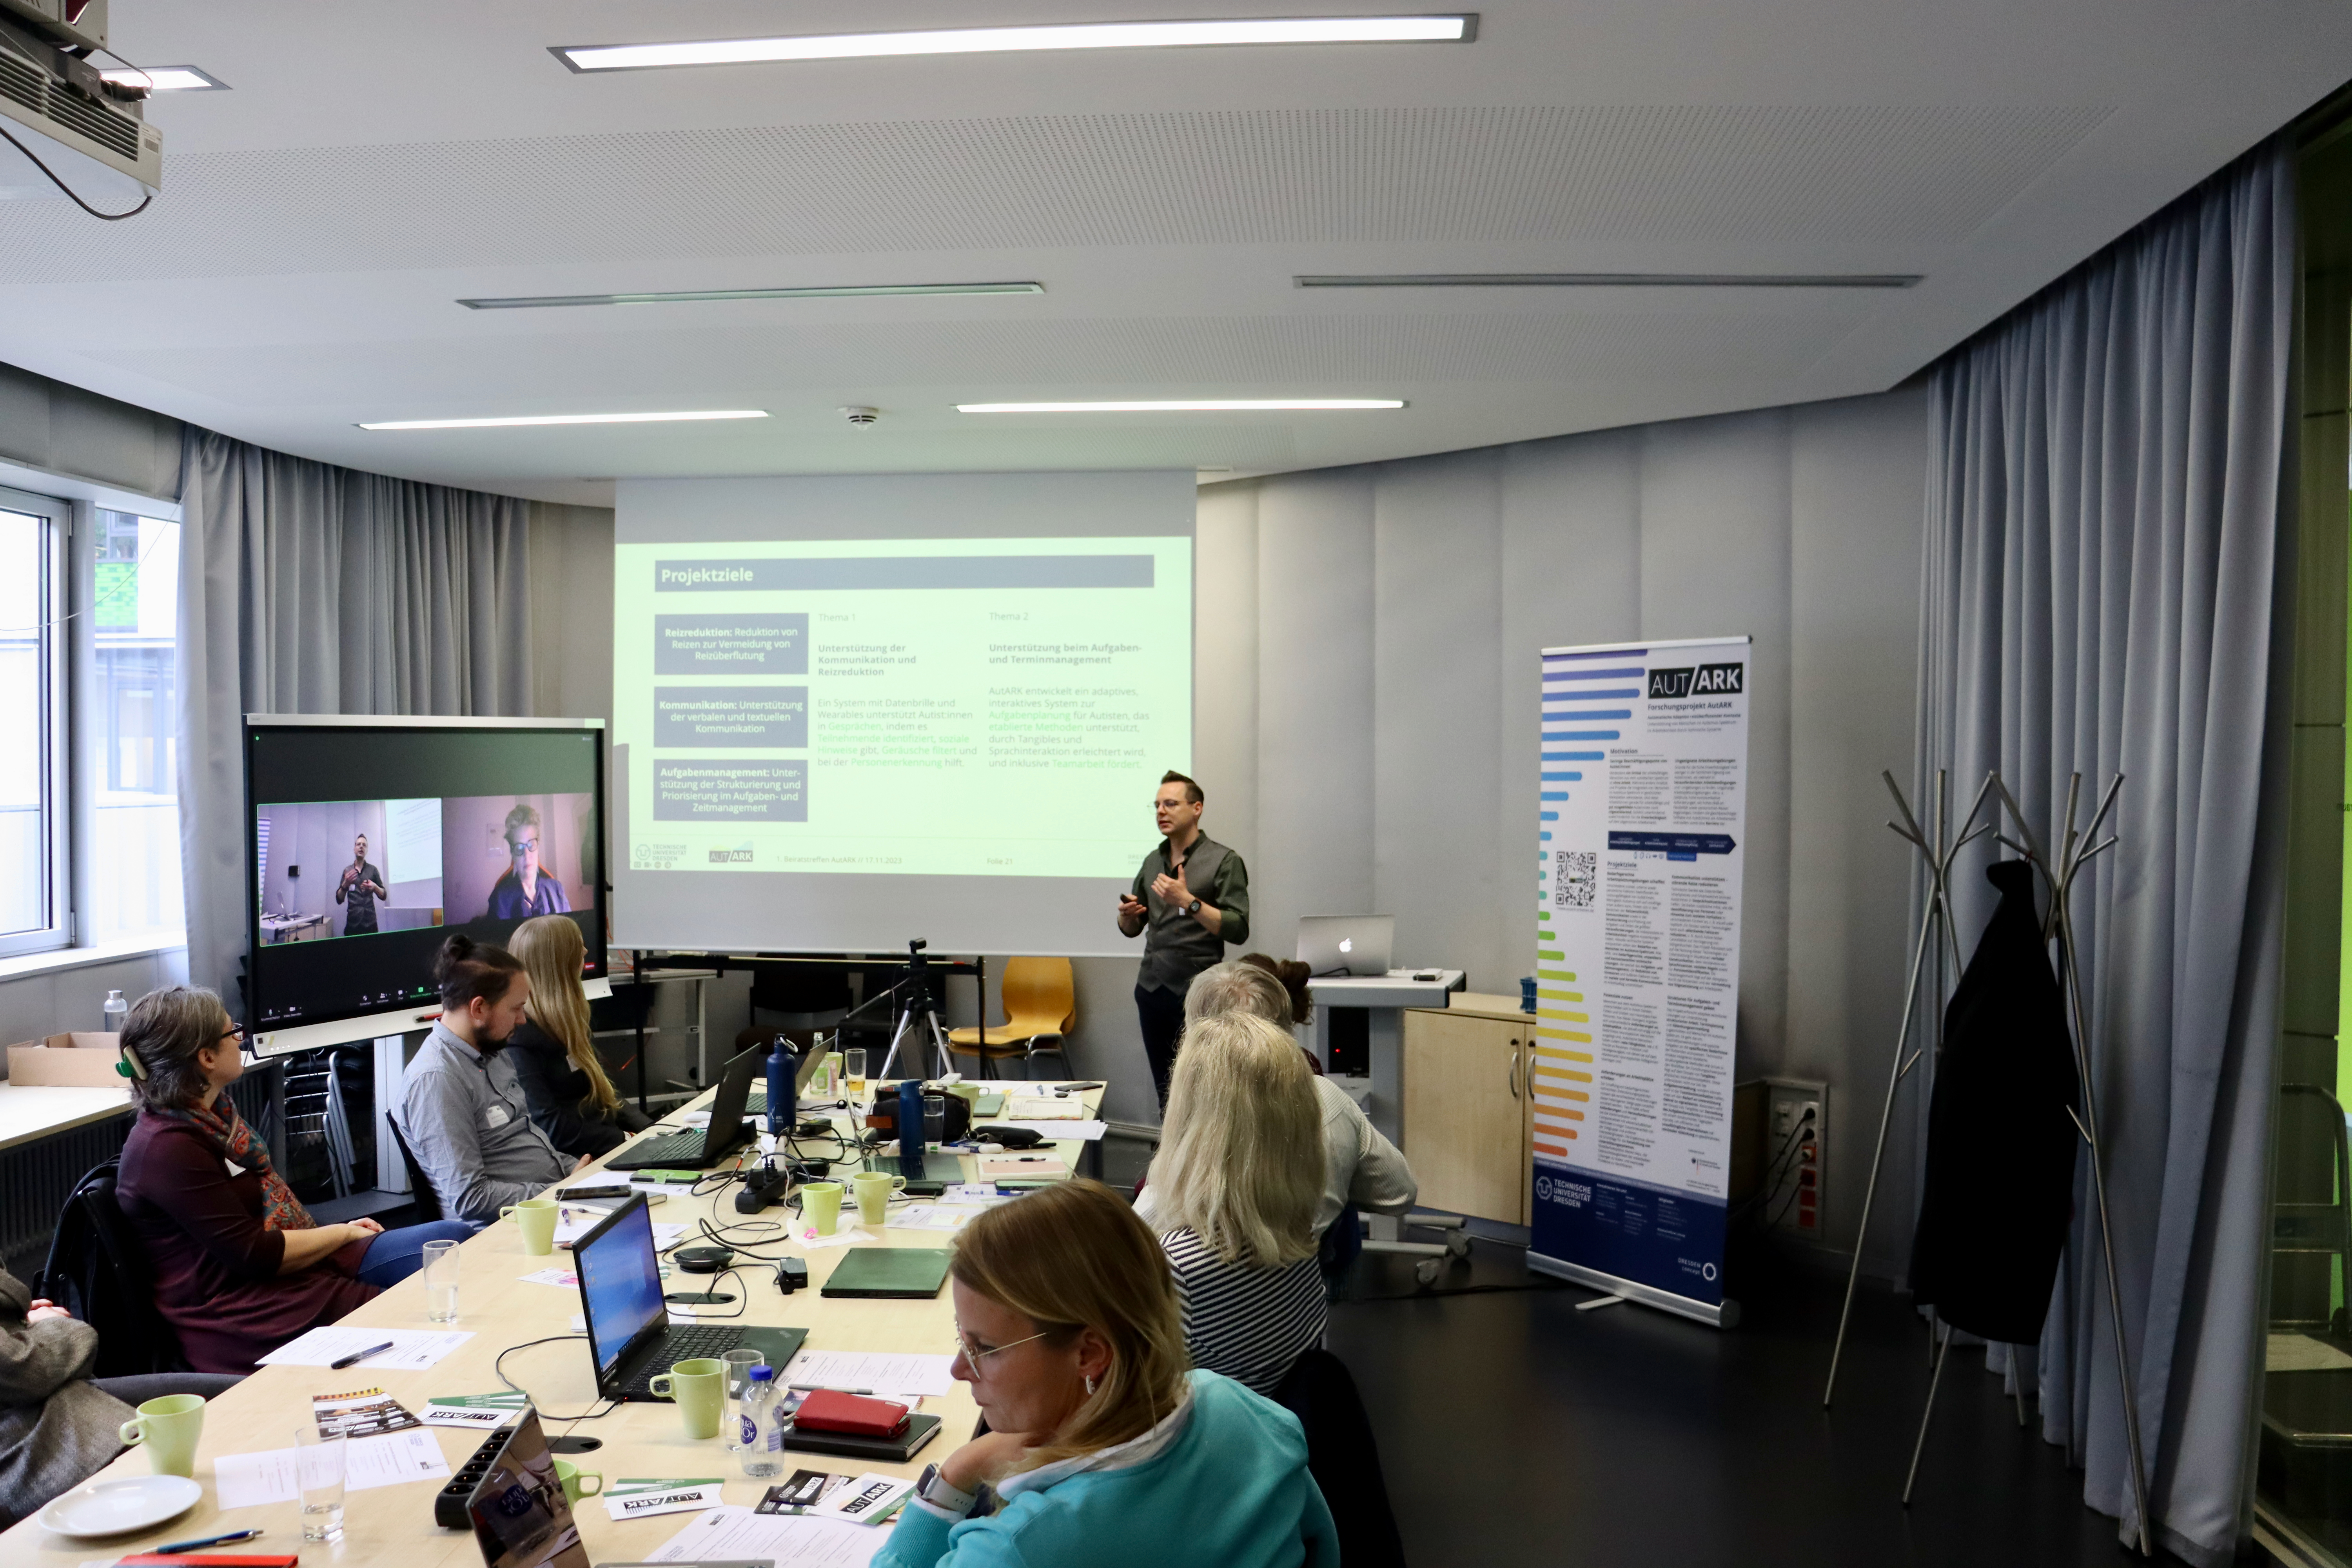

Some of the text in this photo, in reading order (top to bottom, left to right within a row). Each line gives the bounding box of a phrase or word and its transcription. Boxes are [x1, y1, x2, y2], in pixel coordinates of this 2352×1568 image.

[662, 568, 753, 586] Projektziele
[665, 628, 732, 637] Reizreduktion:
[719, 640, 772, 650] Vermeidung
[818, 644, 887, 653] Unterstützung
[989, 644, 1061, 653] Unterstützung
[1091, 644, 1142, 653] Aufgaben-
[695, 651, 765, 662] Reizüberflutung
[1011, 656, 1111, 666] Terminmanagement
[1026, 687, 1072, 695] entwickelt
[1092, 688, 1138, 697] adaptives,
[660, 701, 802, 711] Kommunikation: Unterstützung
[834, 699, 866, 709] System
[1045, 700, 1077, 709] System
[989, 711, 1070, 721] Aufgabenplanung
[1074, 711, 1086, 720] für
[1089, 712, 1130, 721] Autisten,
[696, 724, 765, 733] Kommunikation
[829, 722, 883, 732] Gesprächen,
[1036, 723, 1083, 731] Methoden
[1086, 724, 1139, 733] unterstützt,
[883, 734, 936, 744] identifiziert,
[939, 735, 969, 743] soziale
[989, 735, 1014, 743] durch
[1018, 735, 1060, 745] Tangibles
[882, 746, 929, 754] Geräusche
[989, 747, 1146, 757] Sprachinteraktion erleichtert wird,
[851, 758, 942, 768] Personenerkennung
[1009, 759, 1049, 768] inklusive
[1052, 760, 1104, 768] Teamarbeit
[1107, 760, 1142, 768] fördert.
[661, 768, 769, 778] Aufgabenmanagement:
[661, 780, 697, 790] stützung
[717, 780, 781, 790] Strukturierung
[662, 792, 718, 802] Priorisierung
[733, 792, 778, 802] Aufgaben-
[781, 792, 798, 800] und
[693, 804, 767, 813] Zeitmanagement
[1555, 1179, 1591, 1194] TECHNISCHE
[1553, 1187, 1591, 1202] UNIVERSITÄT
[1553, 1195, 1581, 1208] DRESDEN
[1678, 1258, 1700, 1268] DRESDEN
